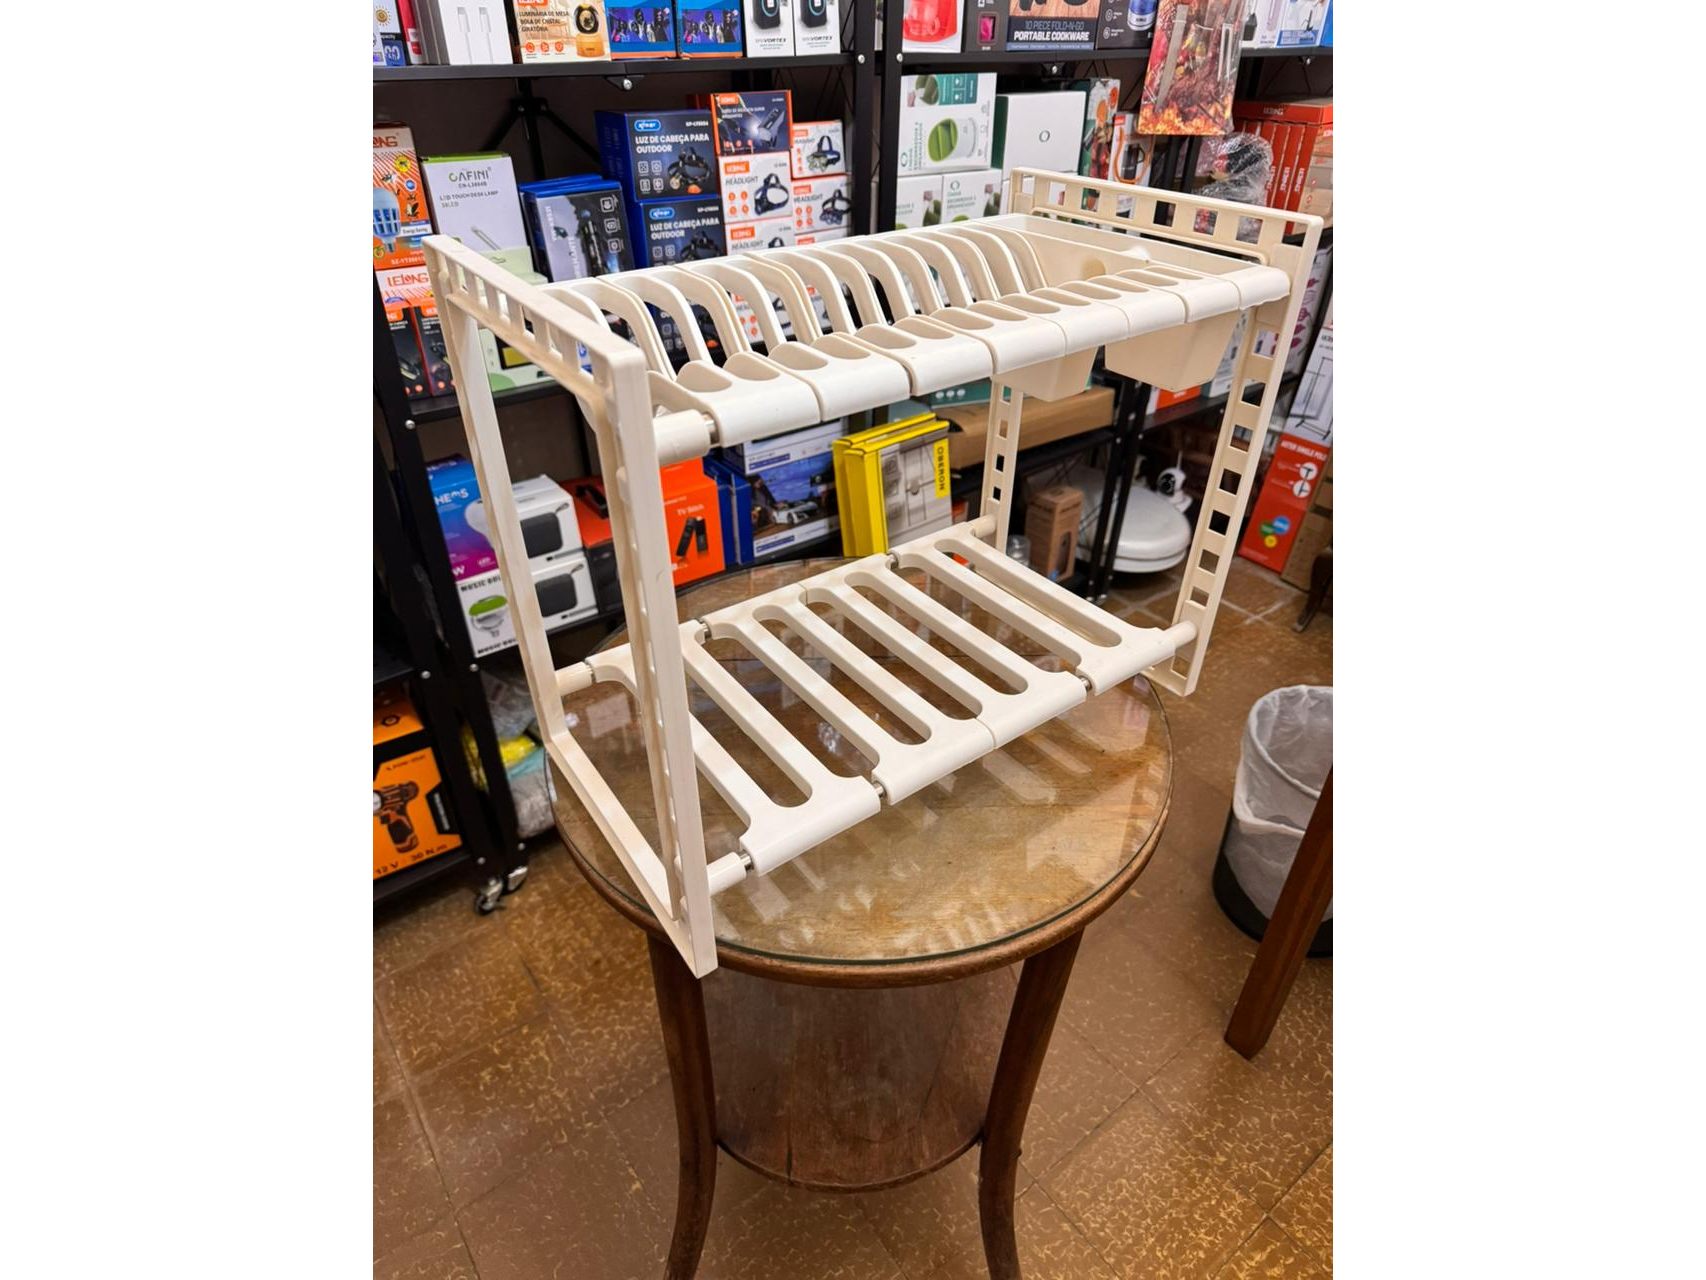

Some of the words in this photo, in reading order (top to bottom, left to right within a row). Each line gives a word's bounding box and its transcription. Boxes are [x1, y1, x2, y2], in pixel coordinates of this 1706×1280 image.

[1033, 20, 1051, 30] PIECE
[1013, 31, 1051, 41] PORTABLE
[1051, 31, 1090, 41] COOKWARE
[635, 135, 649, 145] LUZ
[649, 135, 659, 143] DE
[659, 134, 689, 145] CABEÇA
[690, 133, 710, 142] PARA
[636, 144, 673, 154] OUTDOOR
[448, 168, 489, 182] CAFINI
[725, 176, 758, 186] HEADLIGHT
[650, 223, 663, 232] LUZ
[663, 222, 673, 230] DE
[673, 219, 701, 230] CABEÇA
[701, 217, 720, 226] PARA
[650, 230, 686, 240] OUTDOOR
[731, 240, 763, 250] HEADLIGHT
[936, 446, 945, 491] OBERON
[460, 577, 487, 592] MUSIC
